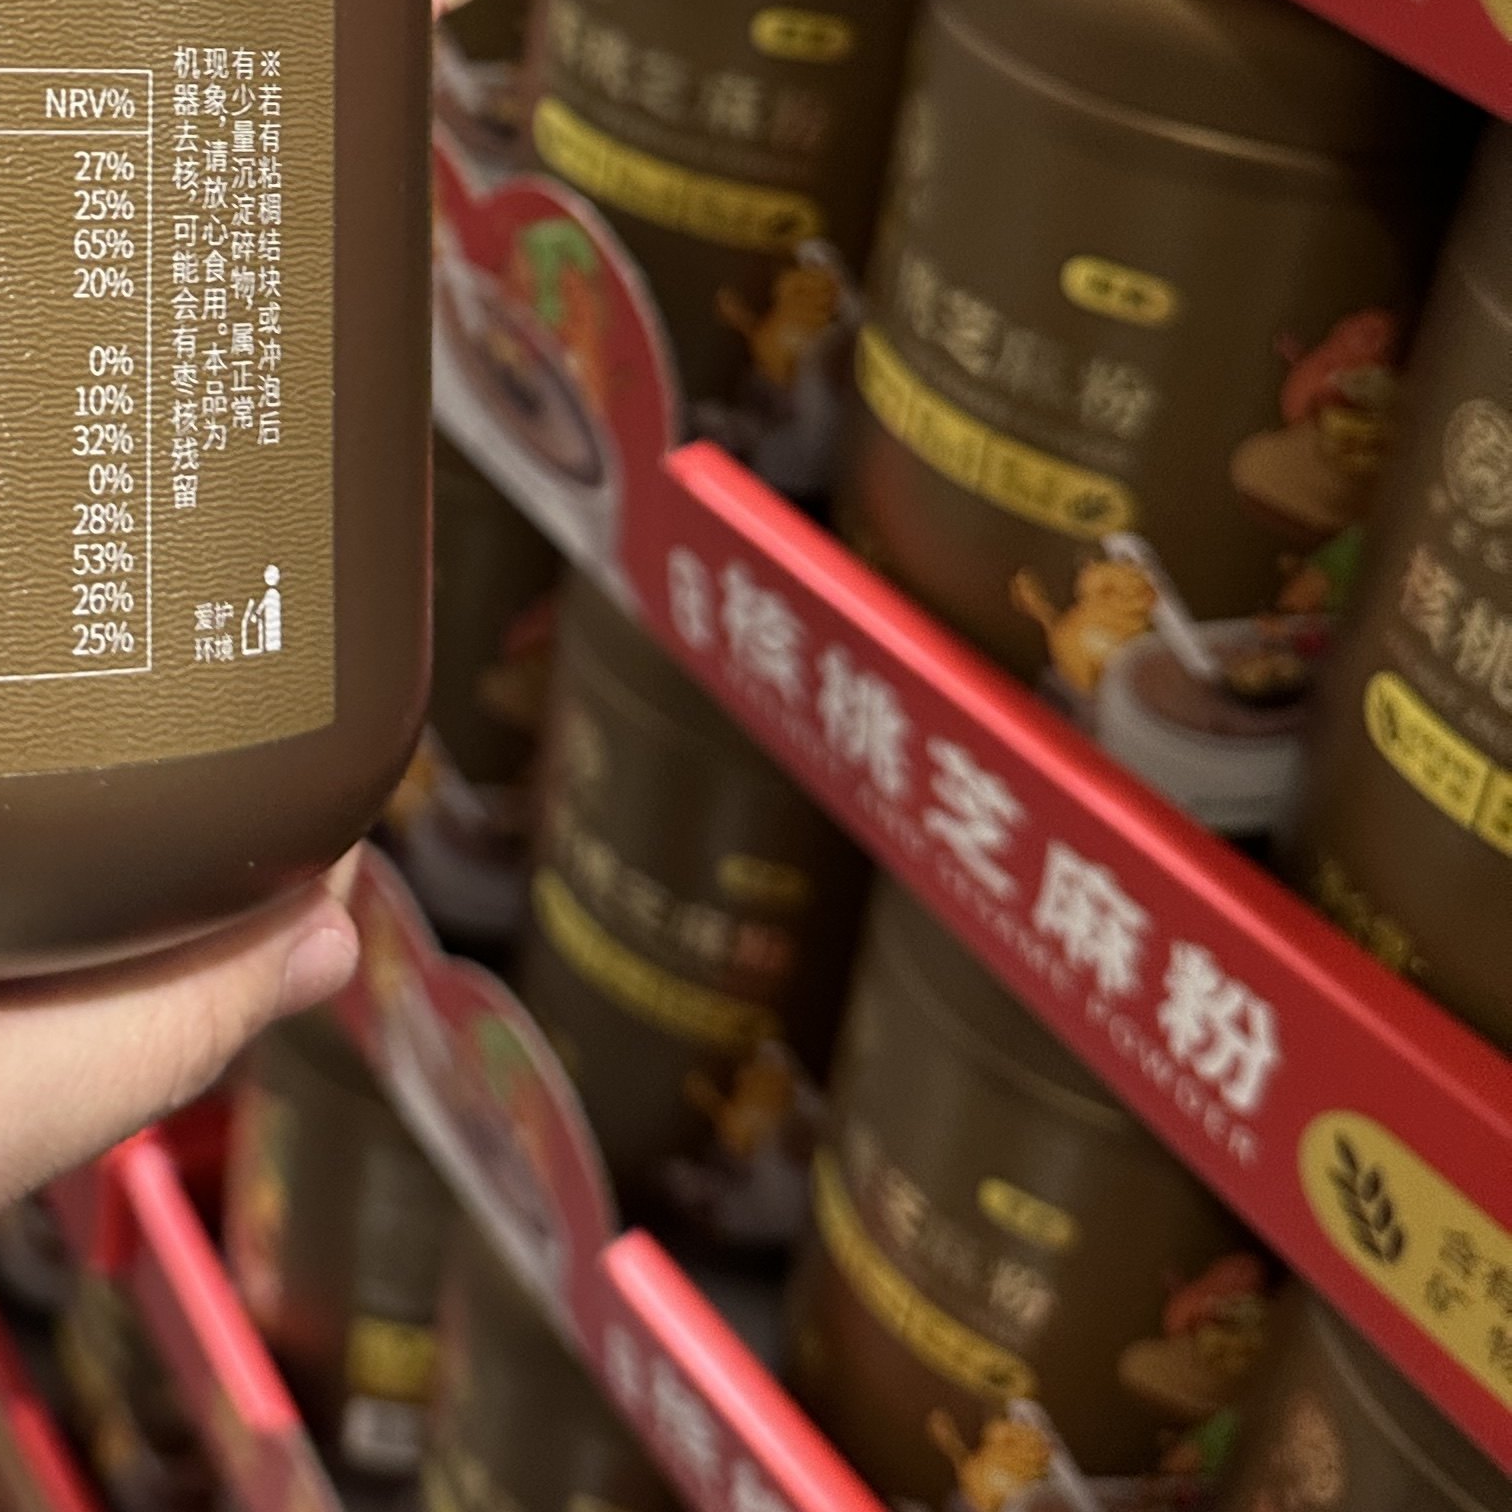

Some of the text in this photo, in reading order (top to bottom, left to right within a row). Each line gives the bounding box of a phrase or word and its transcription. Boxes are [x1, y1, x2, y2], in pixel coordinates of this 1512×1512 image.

[45, 88, 135, 119] NRV%
[74, 151, 135, 182] 27%
[74, 189, 135, 221] 25%
[73, 228, 134, 260] 65%
[73, 267, 134, 299] 20%
[88, 346, 134, 377] 0%
[74, 384, 134, 416] 10%
[72, 423, 134, 456] 32%
[88, 463, 134, 496] 0%
[72, 502, 134, 536] 28%
[72, 541, 134, 575] 53%
[72, 581, 134, 615] 26%
[72, 621, 134, 656] 25%
